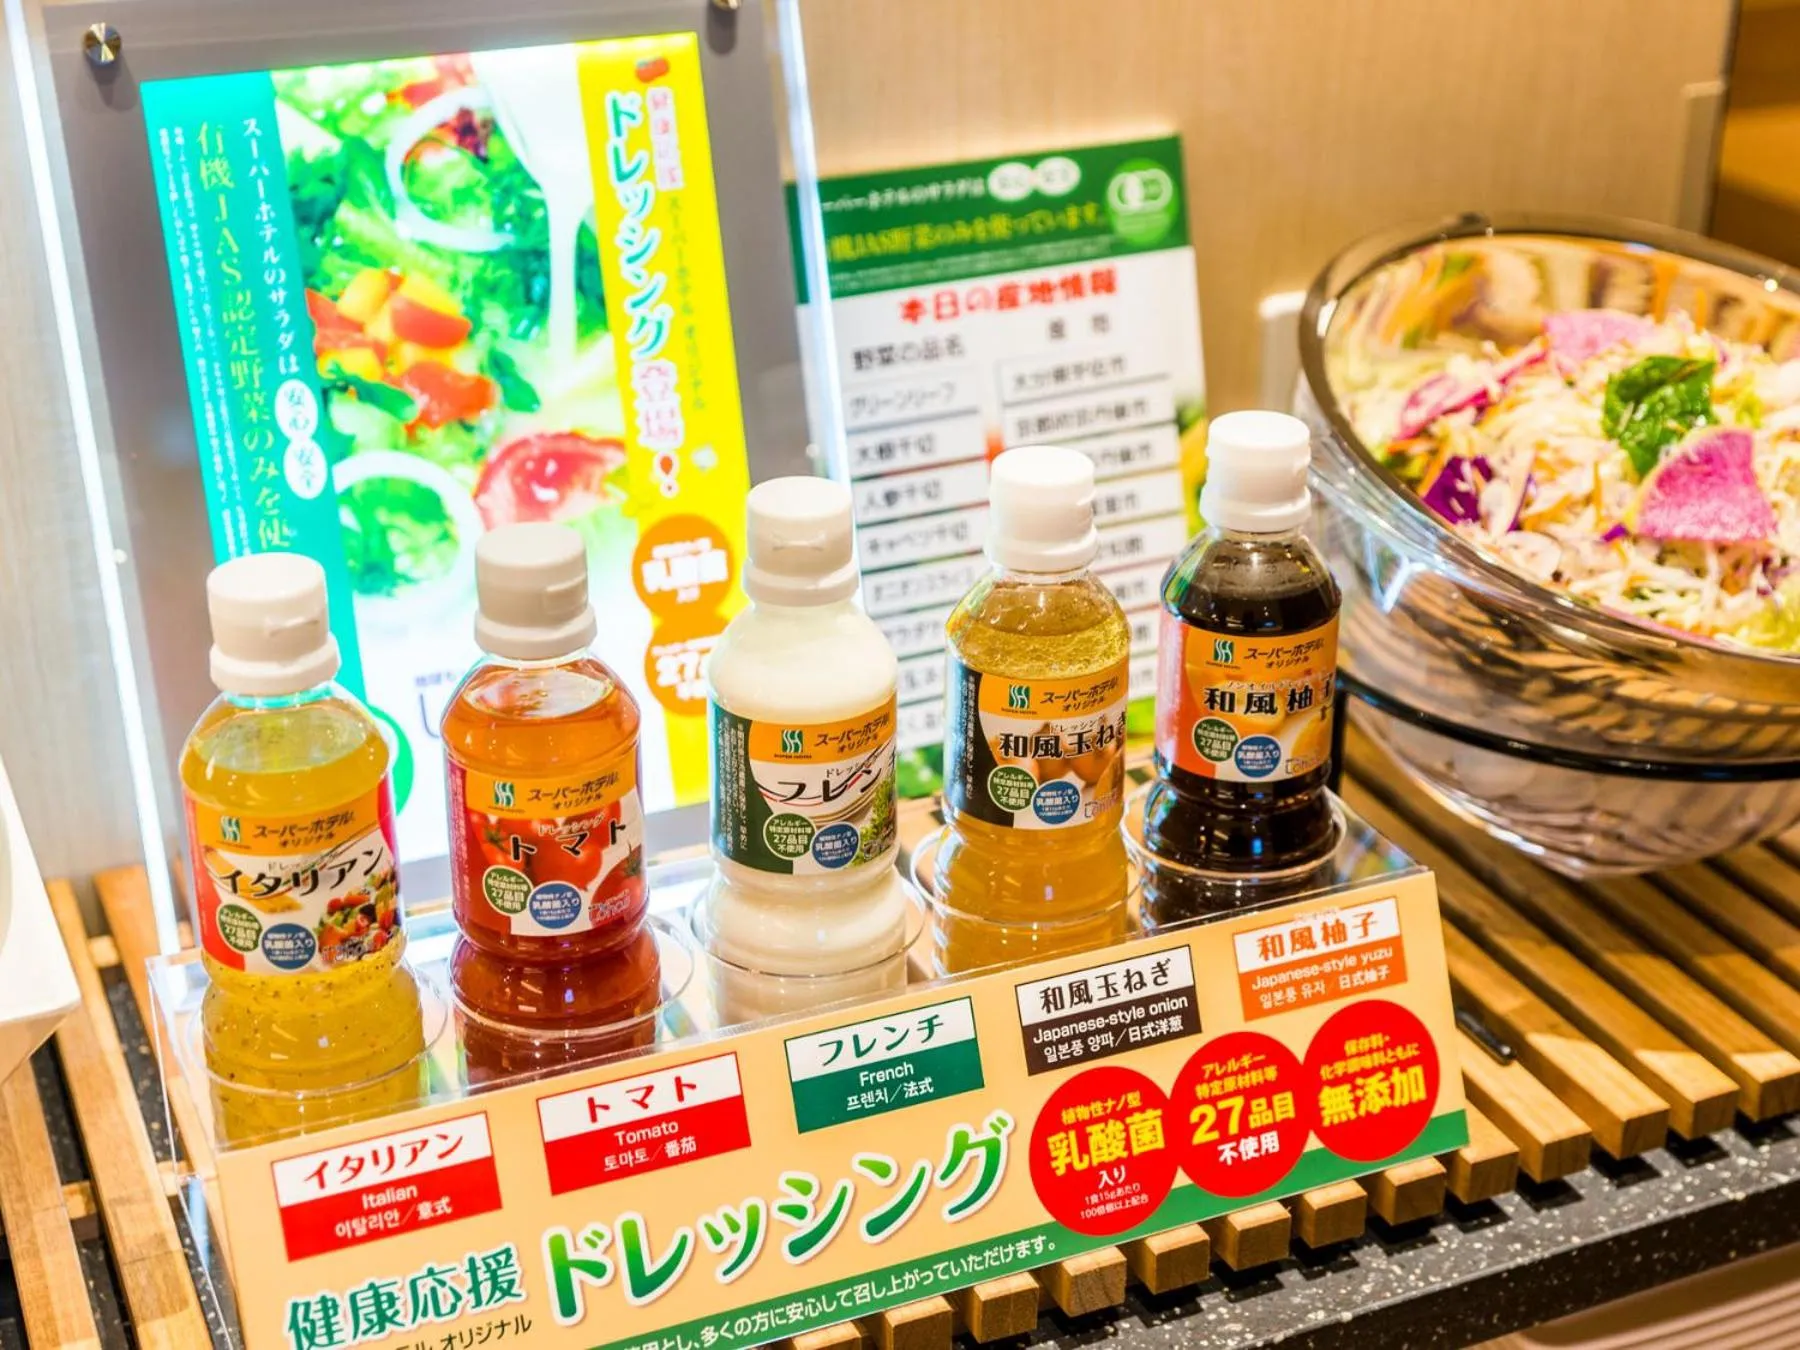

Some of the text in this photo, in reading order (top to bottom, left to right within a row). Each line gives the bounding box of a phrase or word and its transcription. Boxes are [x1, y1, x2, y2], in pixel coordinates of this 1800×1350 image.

[900, 268, 1117, 323] 本日の産地情報
[1039, 676, 1119, 704] スーパーホテル
[528, 772, 618, 801] スーパーホテル
[252, 811, 353, 838] スーパーホテル
[511, 820, 626, 861] トマト
[220, 846, 383, 897] イタリアン
[1257, 911, 1378, 961] 和風柚子
[1040, 958, 1171, 1014] 和風玉ねぎ
[1252, 947, 1393, 990] Japanese-style yuzu
[818, 1014, 943, 1066] フレンチ
[1033, 996, 1188, 1044] Japanese-style onion
[1043, 1039, 1085, 1063] 일본풍
[1202, 1053, 1266, 1079] アレルギー
[859, 1061, 914, 1087] French
[1195, 1065, 1278, 1100] 特定原材料等
[1318, 1065, 1427, 1127] 無添加
[587, 1076, 697, 1124] トマト
[1061, 1091, 1142, 1125] 植物性ナノ型
[1189, 1091, 1295, 1145] 27品目
[614, 1121, 679, 1146] Tomato
[1047, 1108, 1165, 1176] 乳酸菌
[1218, 1131, 1280, 1165] 不使用
[304, 1134, 463, 1190] イタリアン
[1098, 1164, 1126, 1189] 入り
[362, 1185, 418, 1210] Italian
[548, 1114, 1010, 1320] ドレッシング
[287, 1246, 523, 1350] 健康応援
[622, 1233, 1057, 1350] 用とし、多くの方に安心して召し上がっていただけます。
